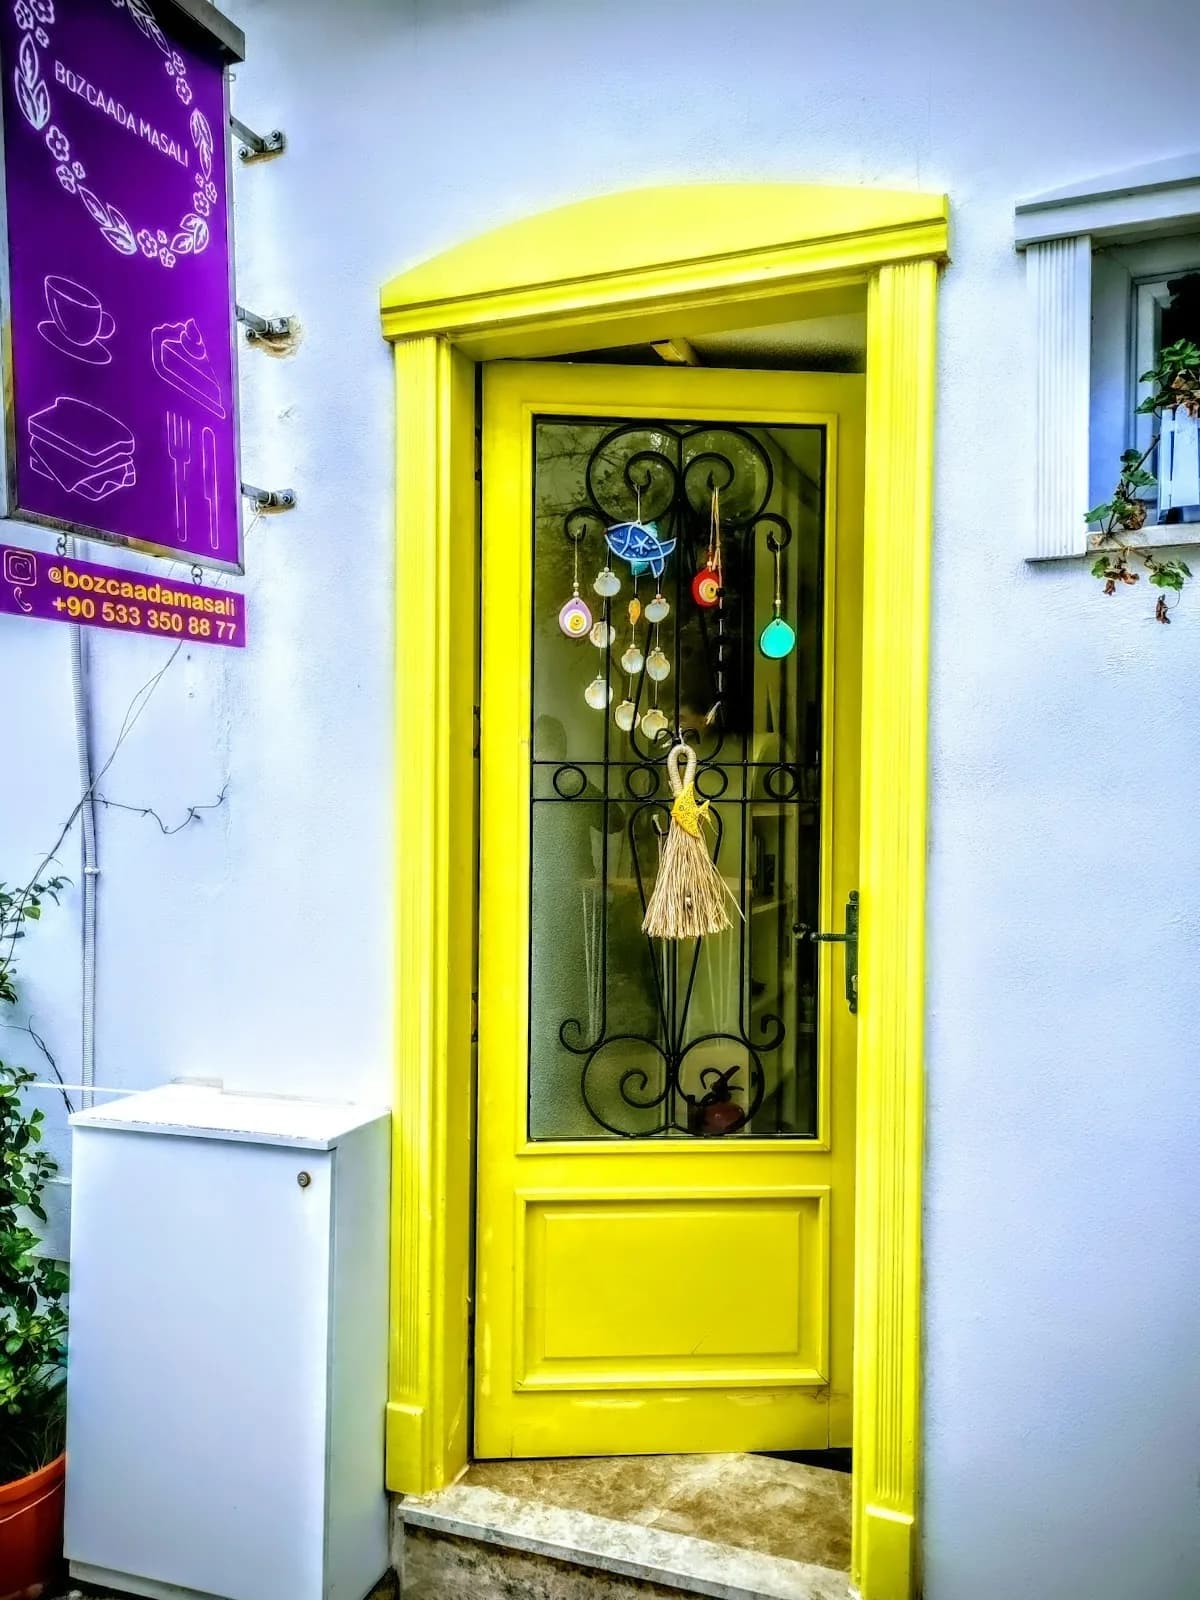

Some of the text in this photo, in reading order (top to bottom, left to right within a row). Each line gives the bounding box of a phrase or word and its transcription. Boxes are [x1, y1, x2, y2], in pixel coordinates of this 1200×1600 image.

[55, 60, 189, 168] BOZCAADA MASALI
[48, 565, 235, 617] @bozcaadamasali
[52, 596, 236, 640] +90 533 350 88 77
